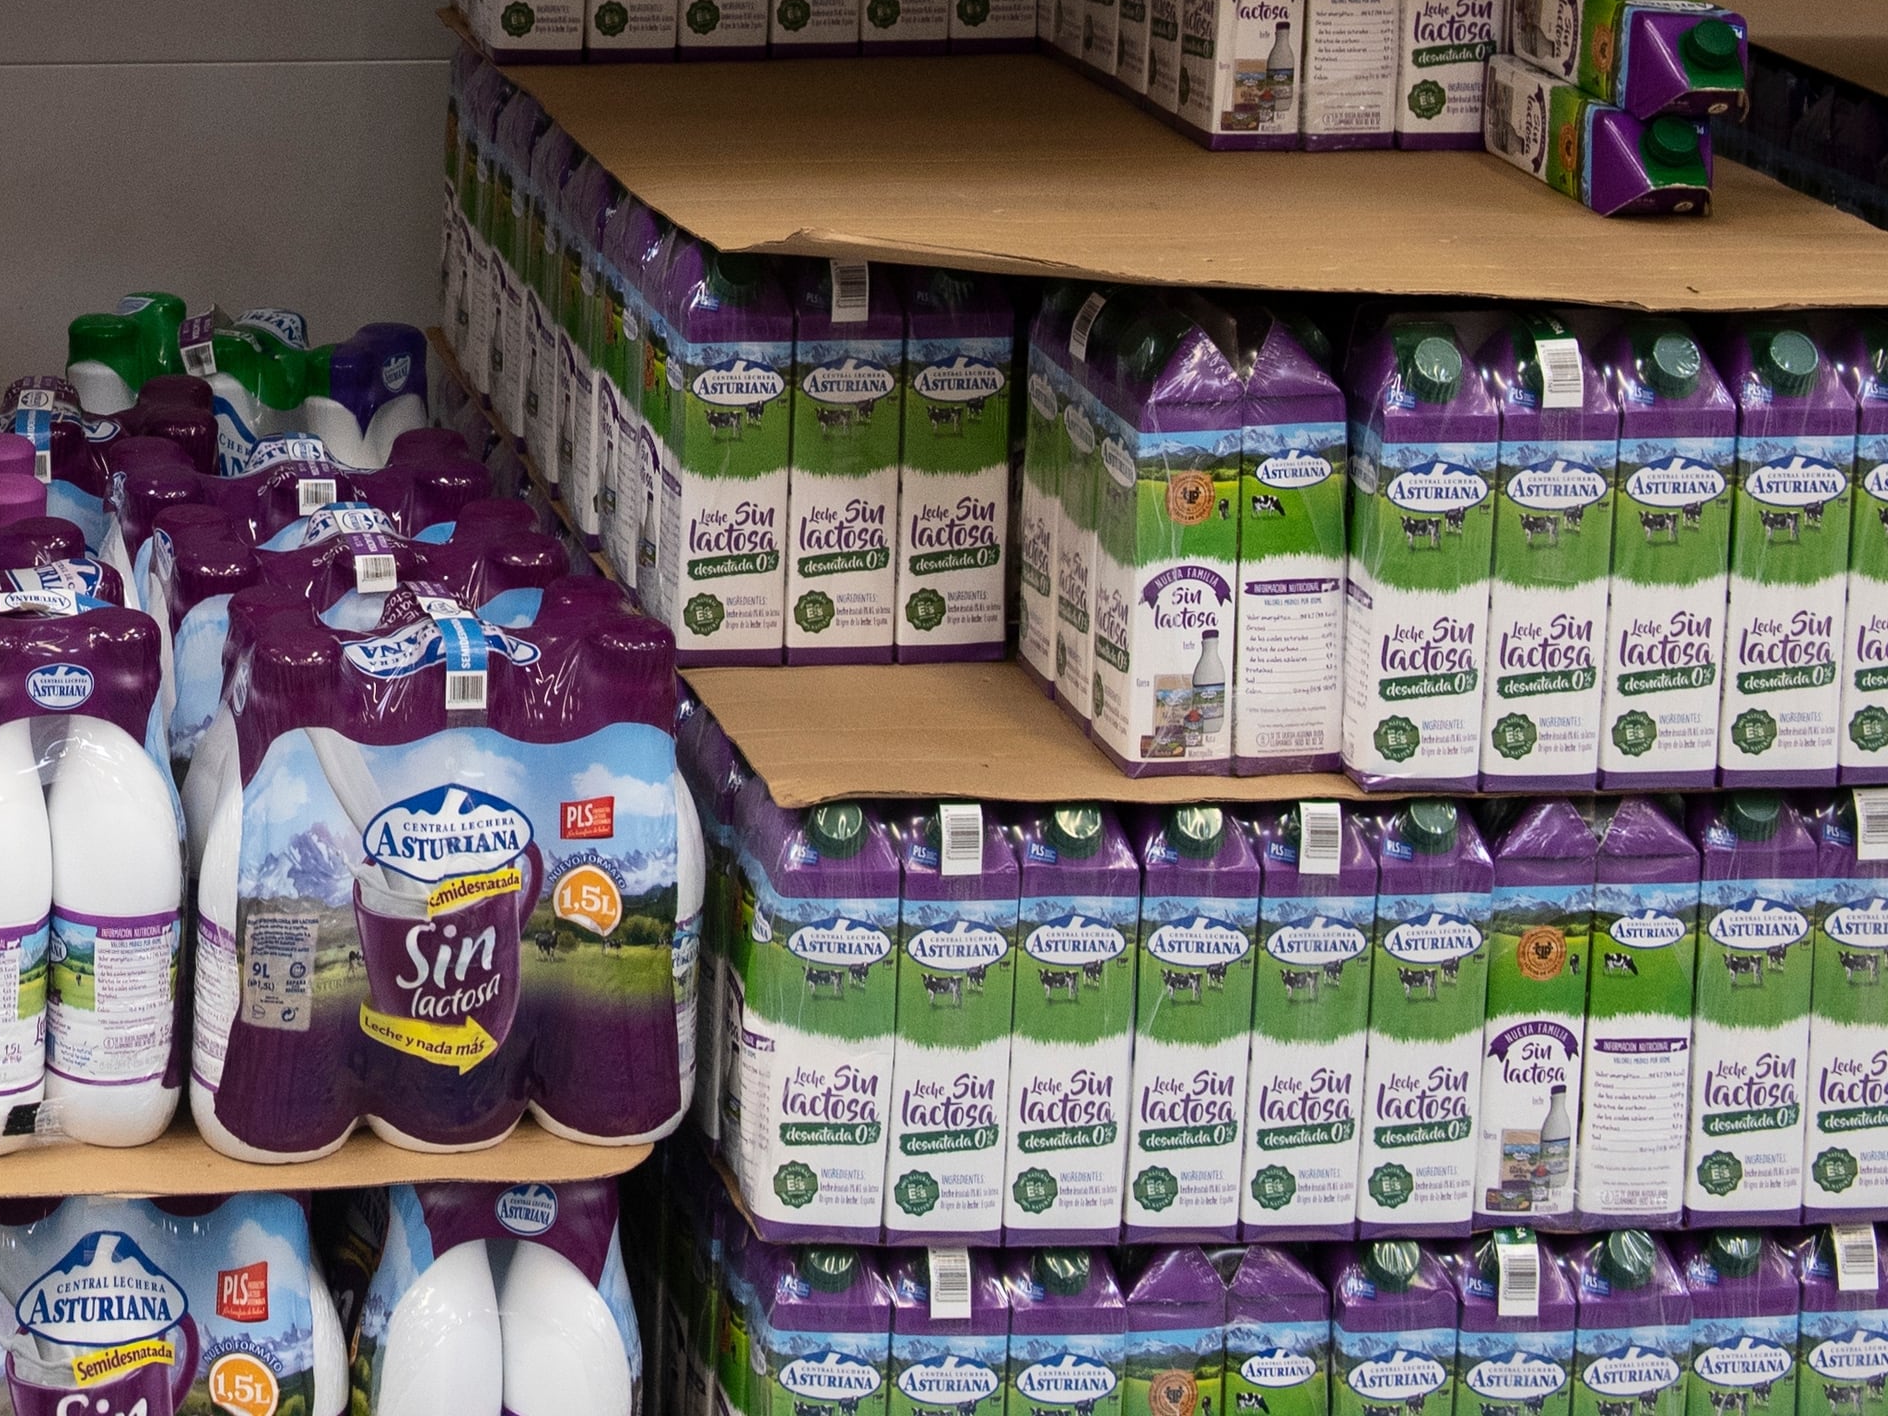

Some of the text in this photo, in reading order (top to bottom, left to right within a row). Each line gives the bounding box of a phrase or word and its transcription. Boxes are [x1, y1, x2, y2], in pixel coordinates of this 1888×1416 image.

[1424, 3, 1449, 21] Leche
[1415, 12, 1491, 43] lactosa
[1630, 478, 1719, 495] ASTURIANA
[1171, 589, 1201, 608] Sin
[1154, 603, 1218, 630] lactosa
[1631, 611, 1711, 637] Leche Sin
[1619, 629, 1712, 667] lactosa
[1624, 663, 1712, 691] desnatada 0%
[377, 825, 522, 857] ASTURIANA
[1029, 936, 1118, 953] ASTURIANA
[29, 1289, 172, 1325] ASTURIANA
[76, 1344, 173, 1379] Semidesnatada
